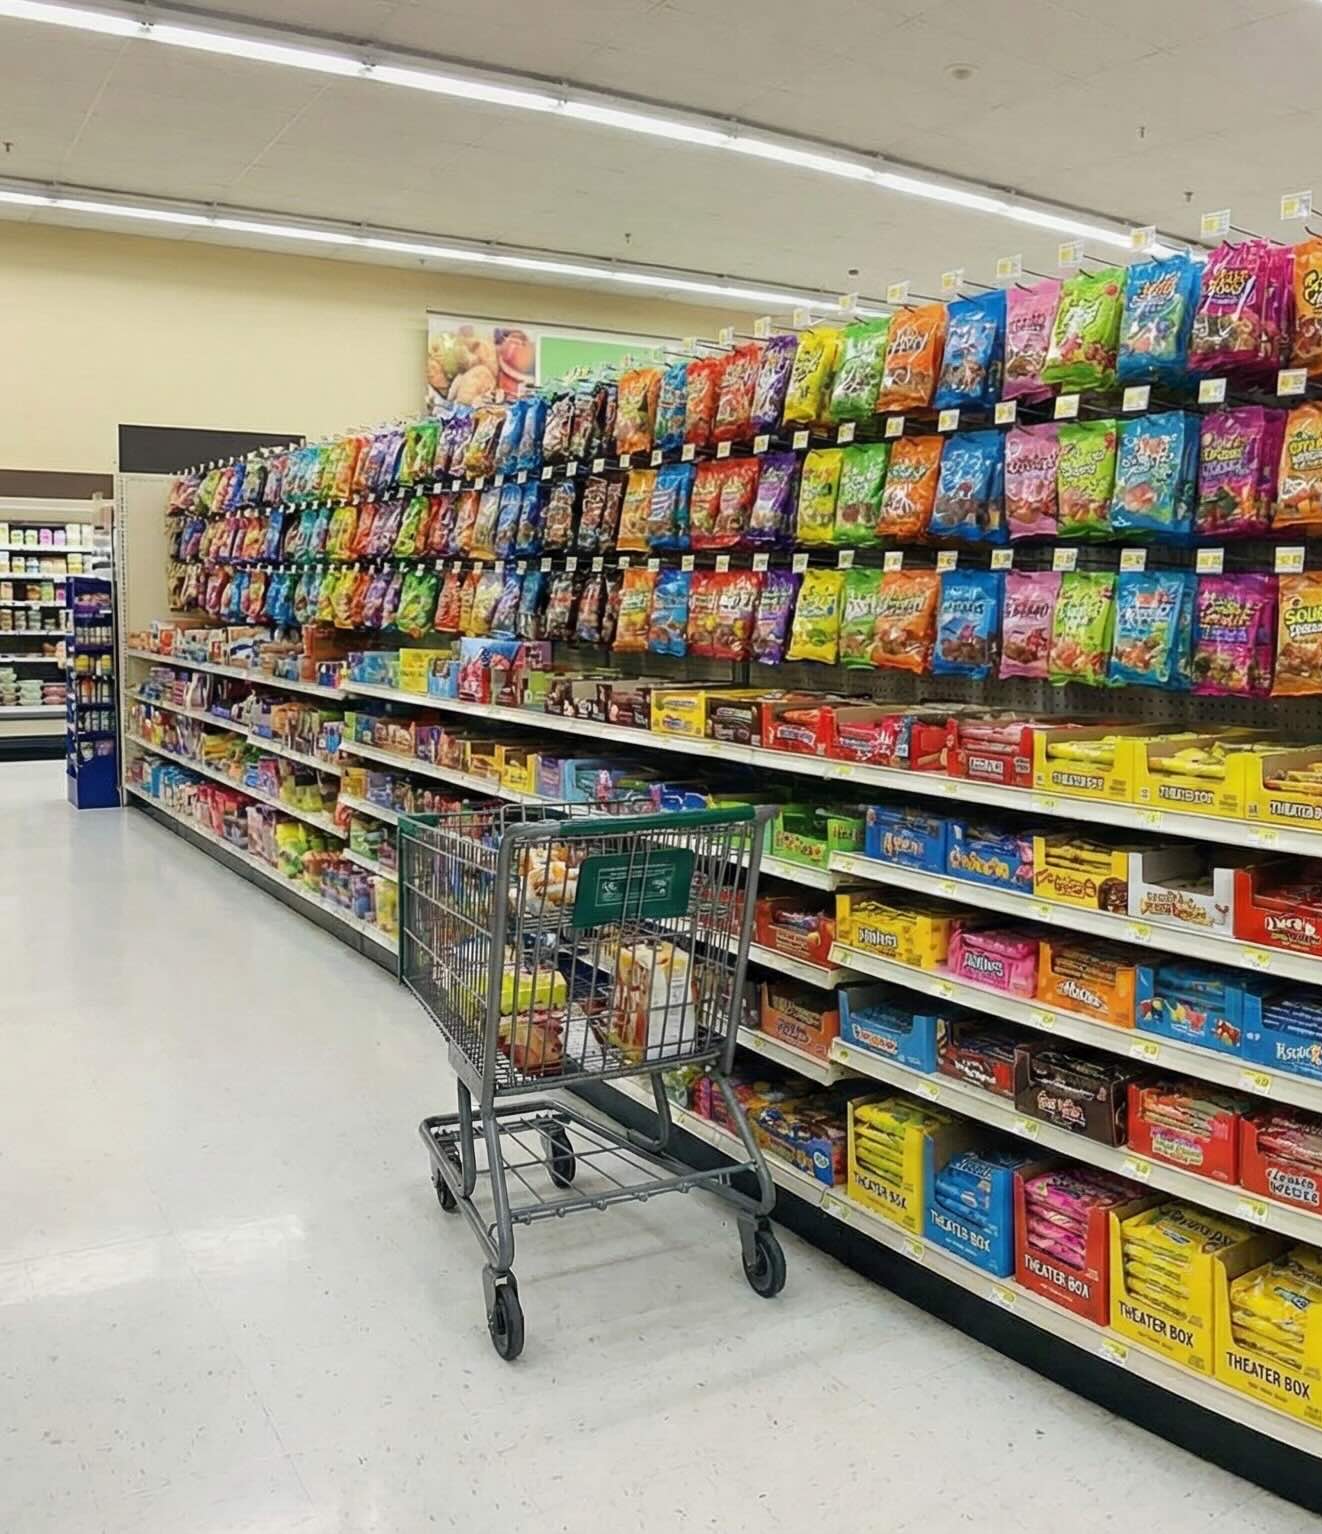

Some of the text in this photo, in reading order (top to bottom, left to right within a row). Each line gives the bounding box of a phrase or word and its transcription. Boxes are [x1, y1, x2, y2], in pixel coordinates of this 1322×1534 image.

[1118, 1300, 1194, 1349] THEATER BOX
[1226, 1351, 1311, 1401] THEATER BOX
